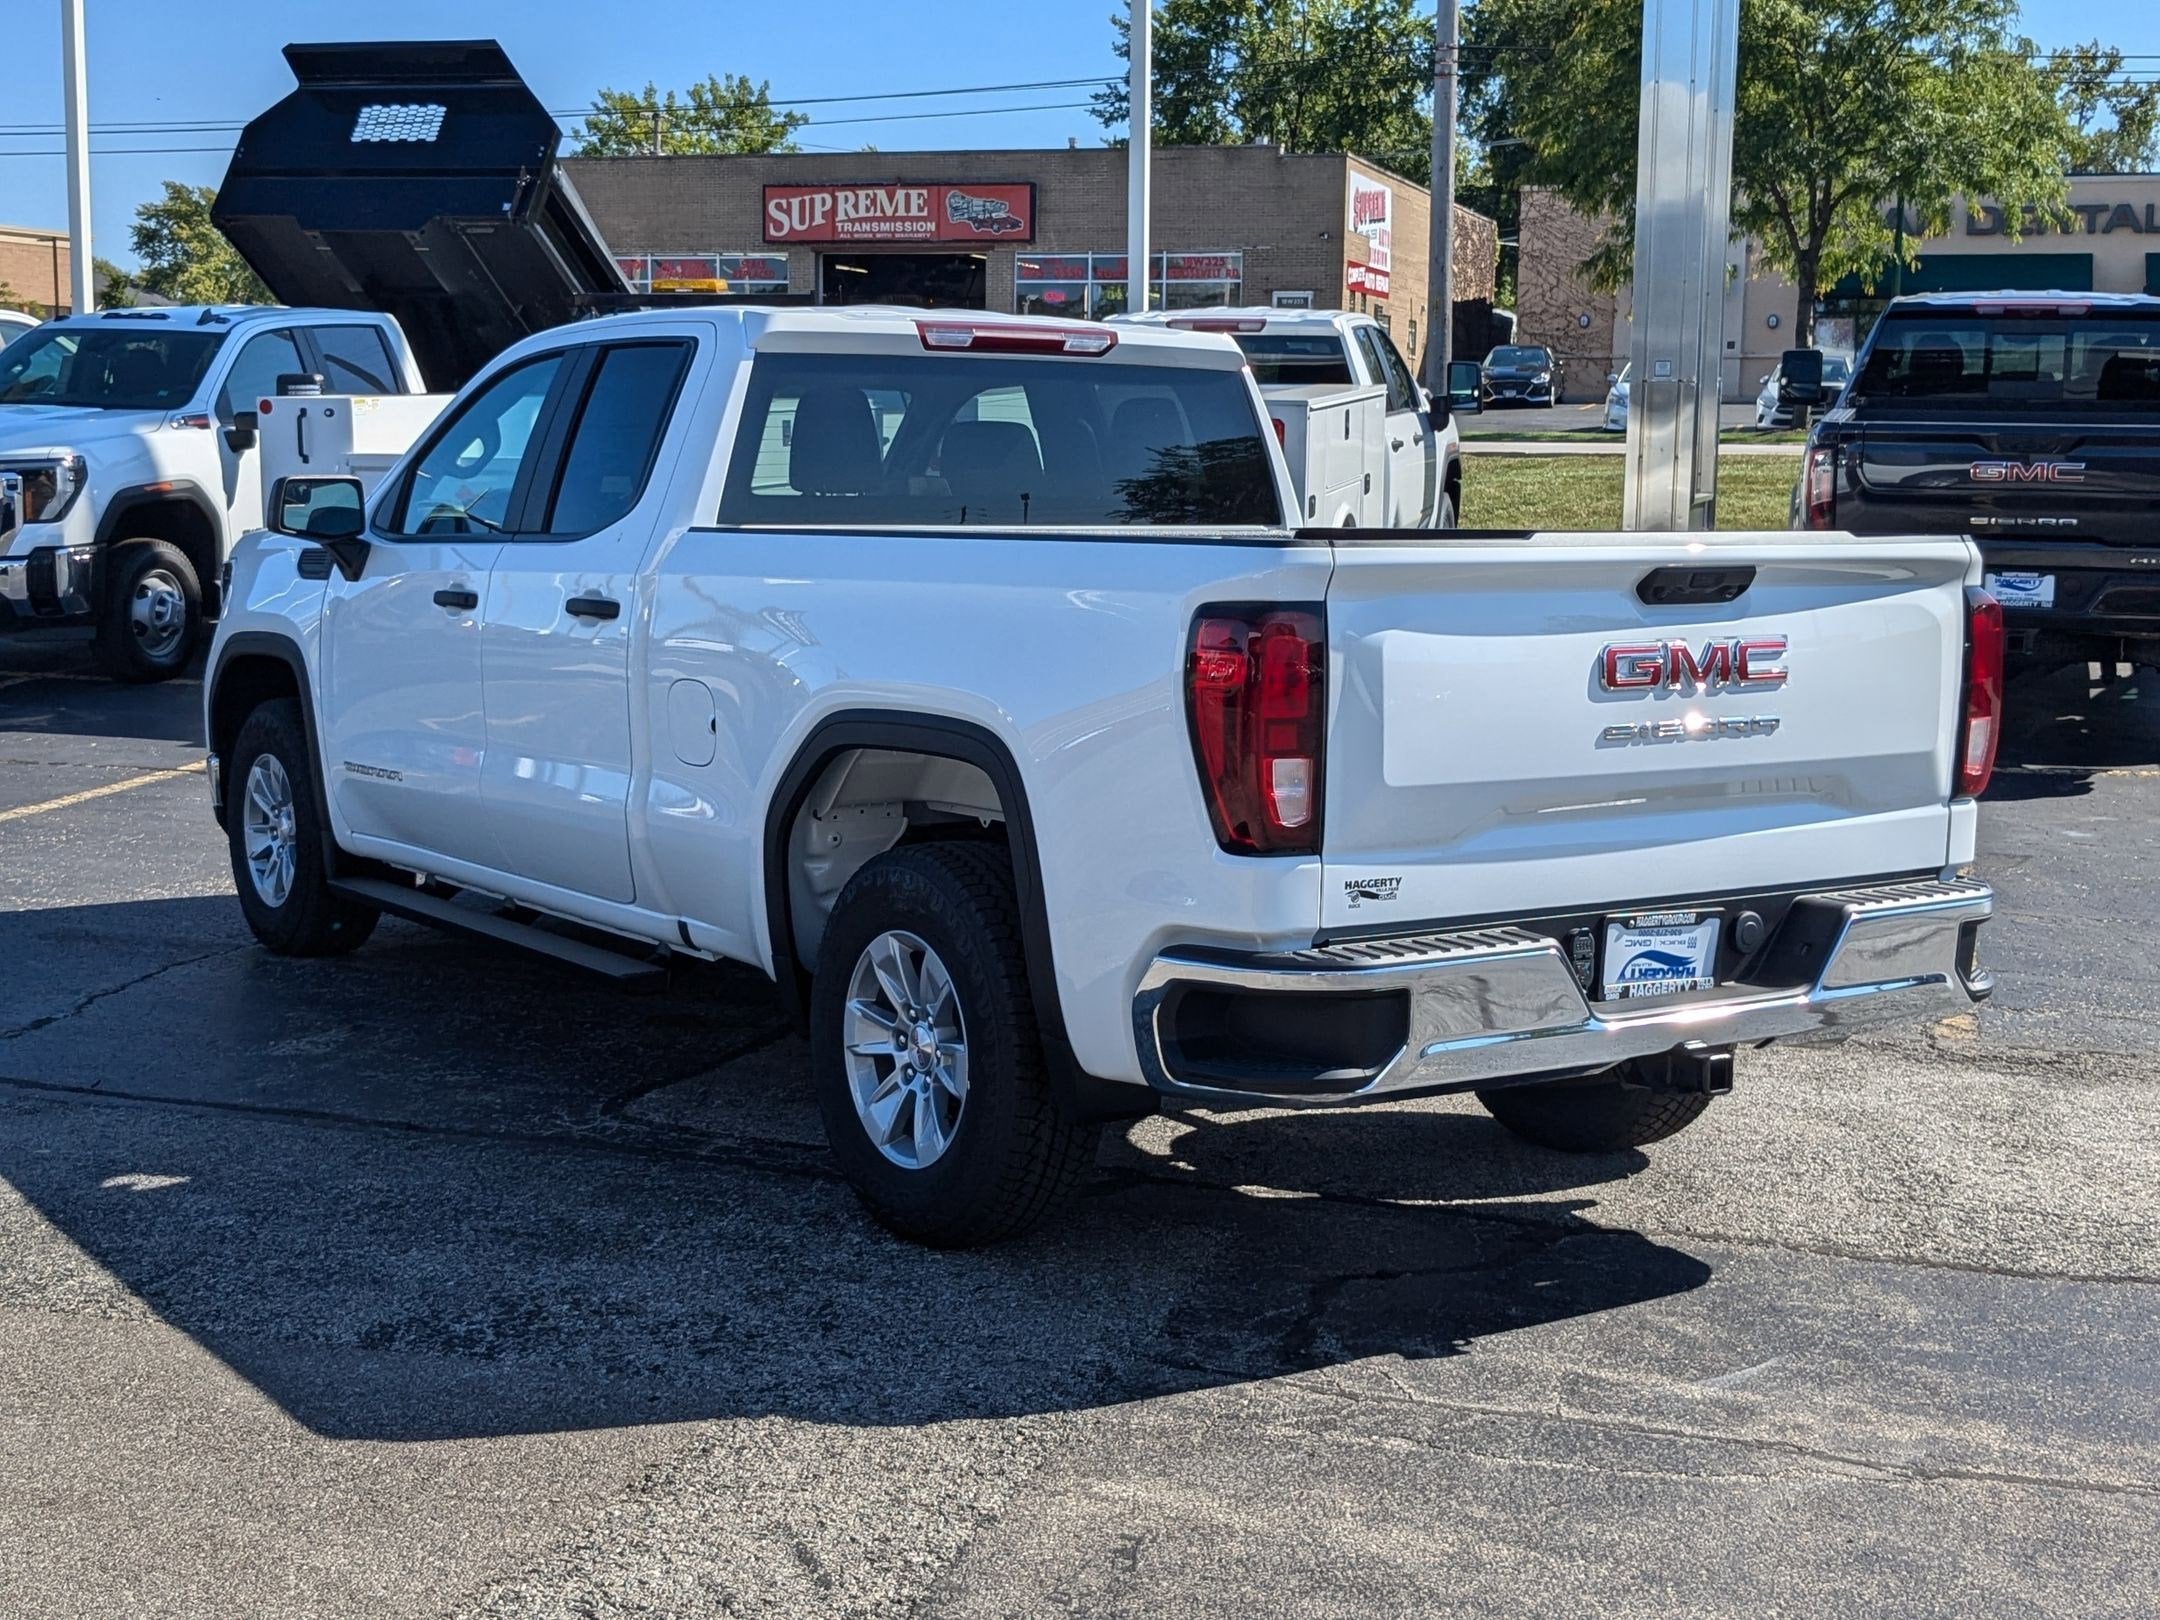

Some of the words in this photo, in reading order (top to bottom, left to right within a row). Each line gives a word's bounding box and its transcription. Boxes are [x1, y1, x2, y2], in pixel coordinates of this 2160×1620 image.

[768, 188, 929, 237] SUPREME
[1353, 187, 1386, 232] SUPREME
[836, 221, 936, 232] TRANSMISSION
[1970, 461, 2086, 482] GMC
[1600, 634, 1789, 692] GMC
[1345, 877, 1402, 890] HAGGERTY
[1624, 939, 1652, 948] GMC
[1629, 980, 1690, 998] HAGGERTY
